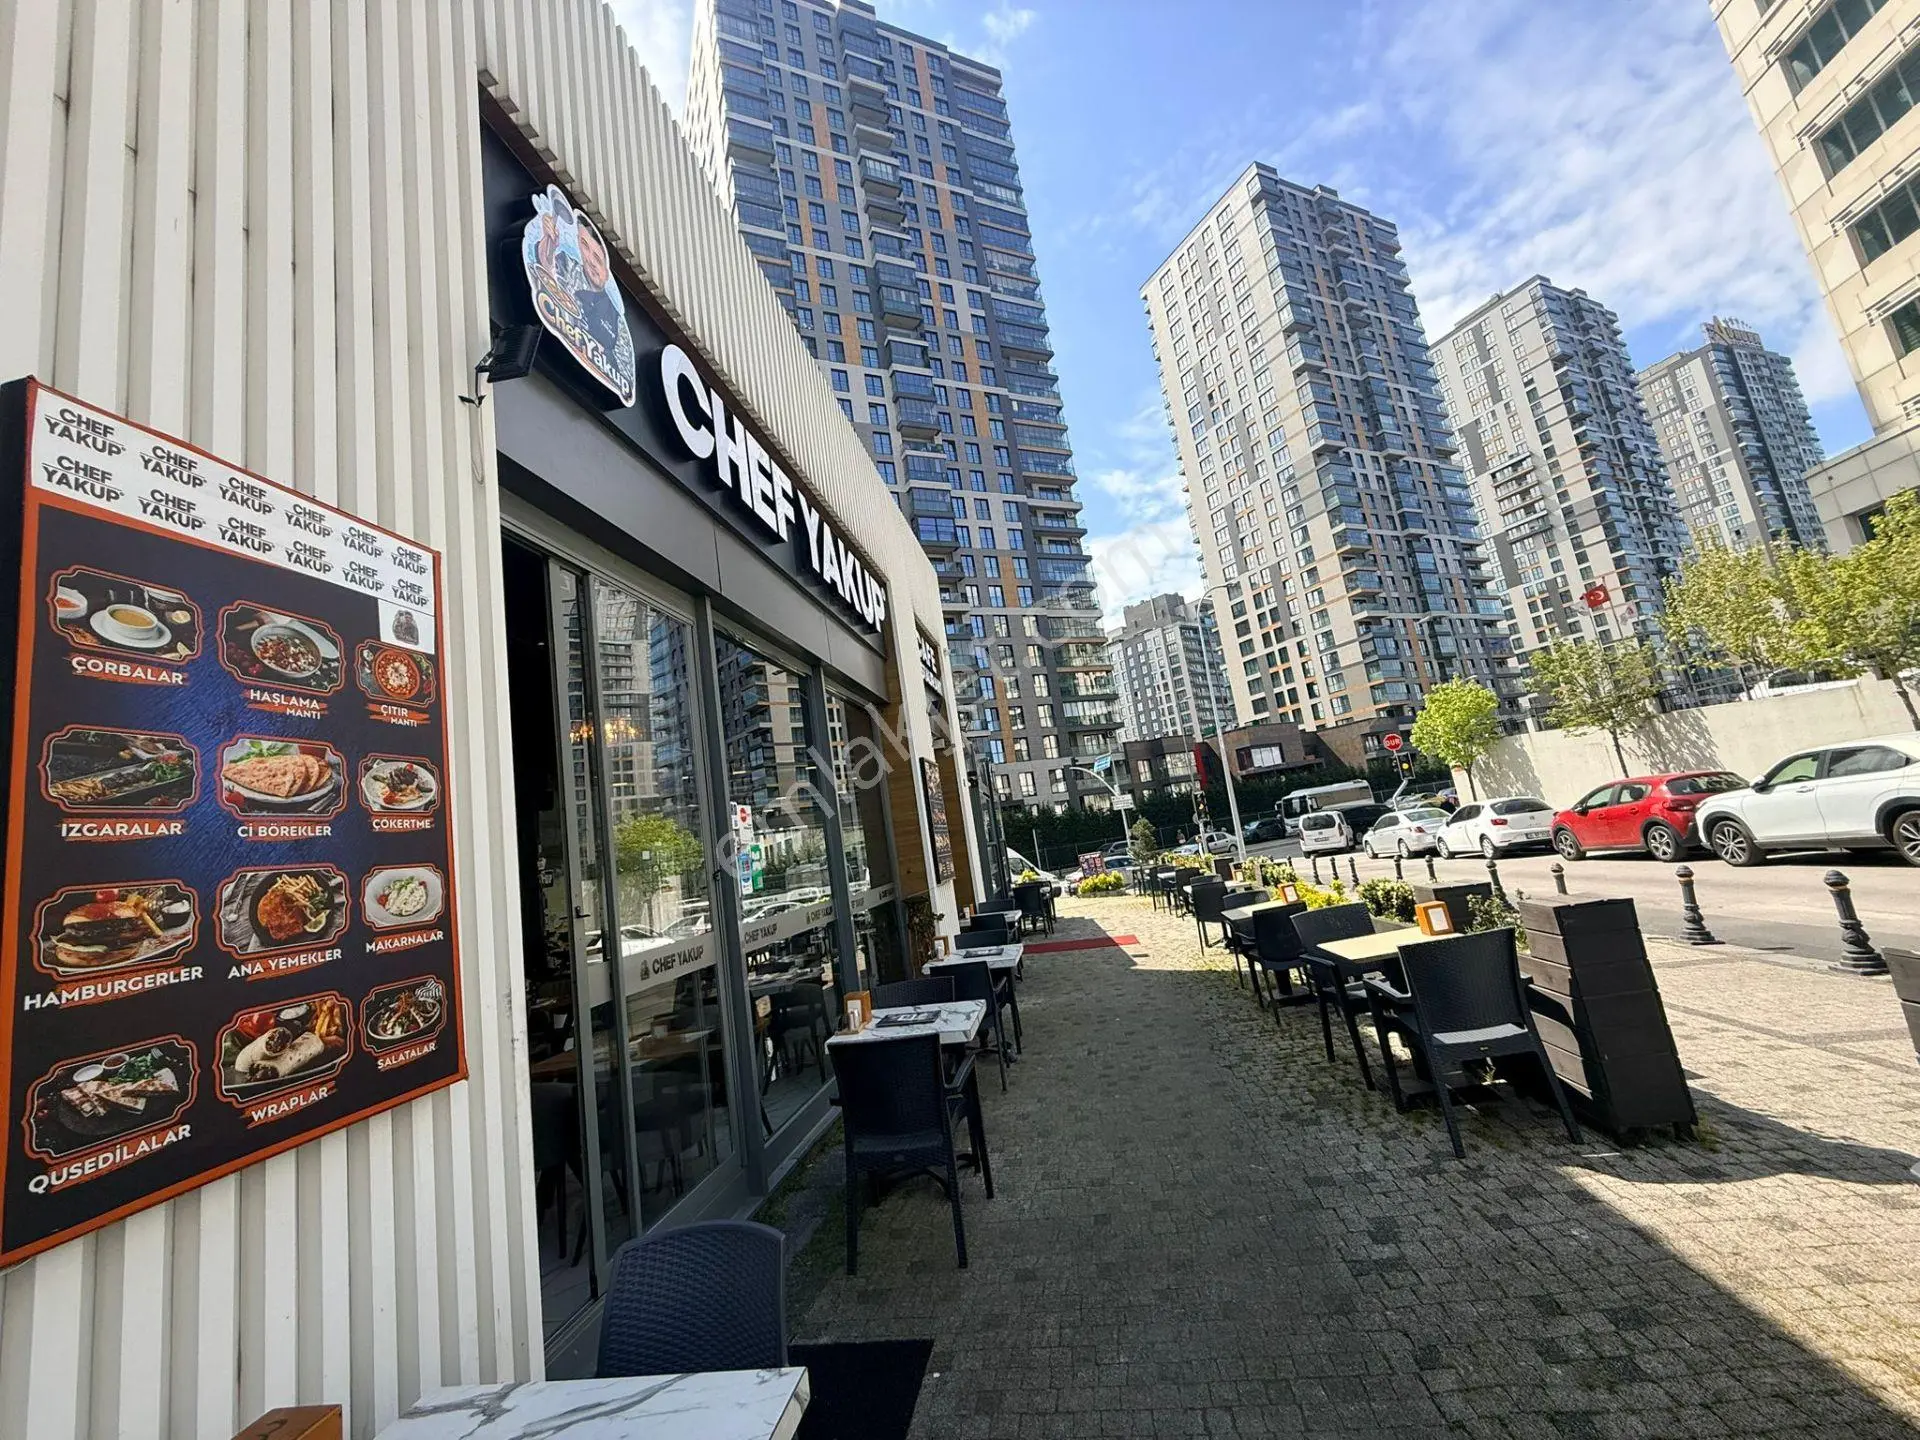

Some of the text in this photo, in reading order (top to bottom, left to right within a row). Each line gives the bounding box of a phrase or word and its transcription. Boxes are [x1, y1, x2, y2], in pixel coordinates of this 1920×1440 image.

[538, 293, 583, 346] Chef
[582, 330, 630, 395] Yakup
[60, 408, 115, 437] CHEF
[44, 417, 123, 457] YAKUP
[57, 455, 112, 483] CHEF
[152, 445, 198, 471] CHEF
[139, 453, 204, 489] YAKUP
[42, 465, 121, 502] YAKUP
[228, 476, 267, 500] CHEF
[660, 344, 886, 633] CHEF YAKUP
[150, 489, 196, 514] CHEF
[219, 486, 273, 516] YAKUP
[138, 499, 204, 531] YAKUP
[284, 512, 331, 539] YAKUP
[293, 503, 326, 524] CHEF
[218, 526, 273, 554] YAKUP
[228, 517, 266, 539] CHEF
[348, 526, 377, 545] CHEF
[292, 540, 326, 560] CHEF
[342, 534, 382, 558] YAKUP
[397, 546, 422, 563] CHEF
[285, 549, 332, 575] YAKUP
[349, 560, 378, 578] CHEF
[391, 554, 427, 576] YAKUP
[342, 569, 383, 592] YAKUP
[398, 578, 423, 595] CHEF
[392, 587, 428, 607] YAKUP
[71, 656, 184, 685] ÇORBALAR
[250, 689, 320, 710] HAŞLAMA
[380, 704, 409, 718] ÇITIR
[286, 707, 321, 720] MANTI
[390, 717, 418, 728] MANTI
[1385, 738, 1401, 747] DUR
[61, 823, 182, 837] IZGARALAR
[258, 822, 332, 837] BÖREKLER
[366, 931, 444, 953] MAKARNALAR
[744, 929, 760, 944] CHEF
[227, 949, 342, 979] ANA YEMEKLER
[652, 945, 704, 975] CHEF YAKUP
[23, 966, 203, 1011] HAMBURGERLER
[377, 1042, 436, 1069] SALATALAR
[251, 1087, 328, 1122] WRAPLAR
[28, 1124, 192, 1194] QUSEDİLALAR
